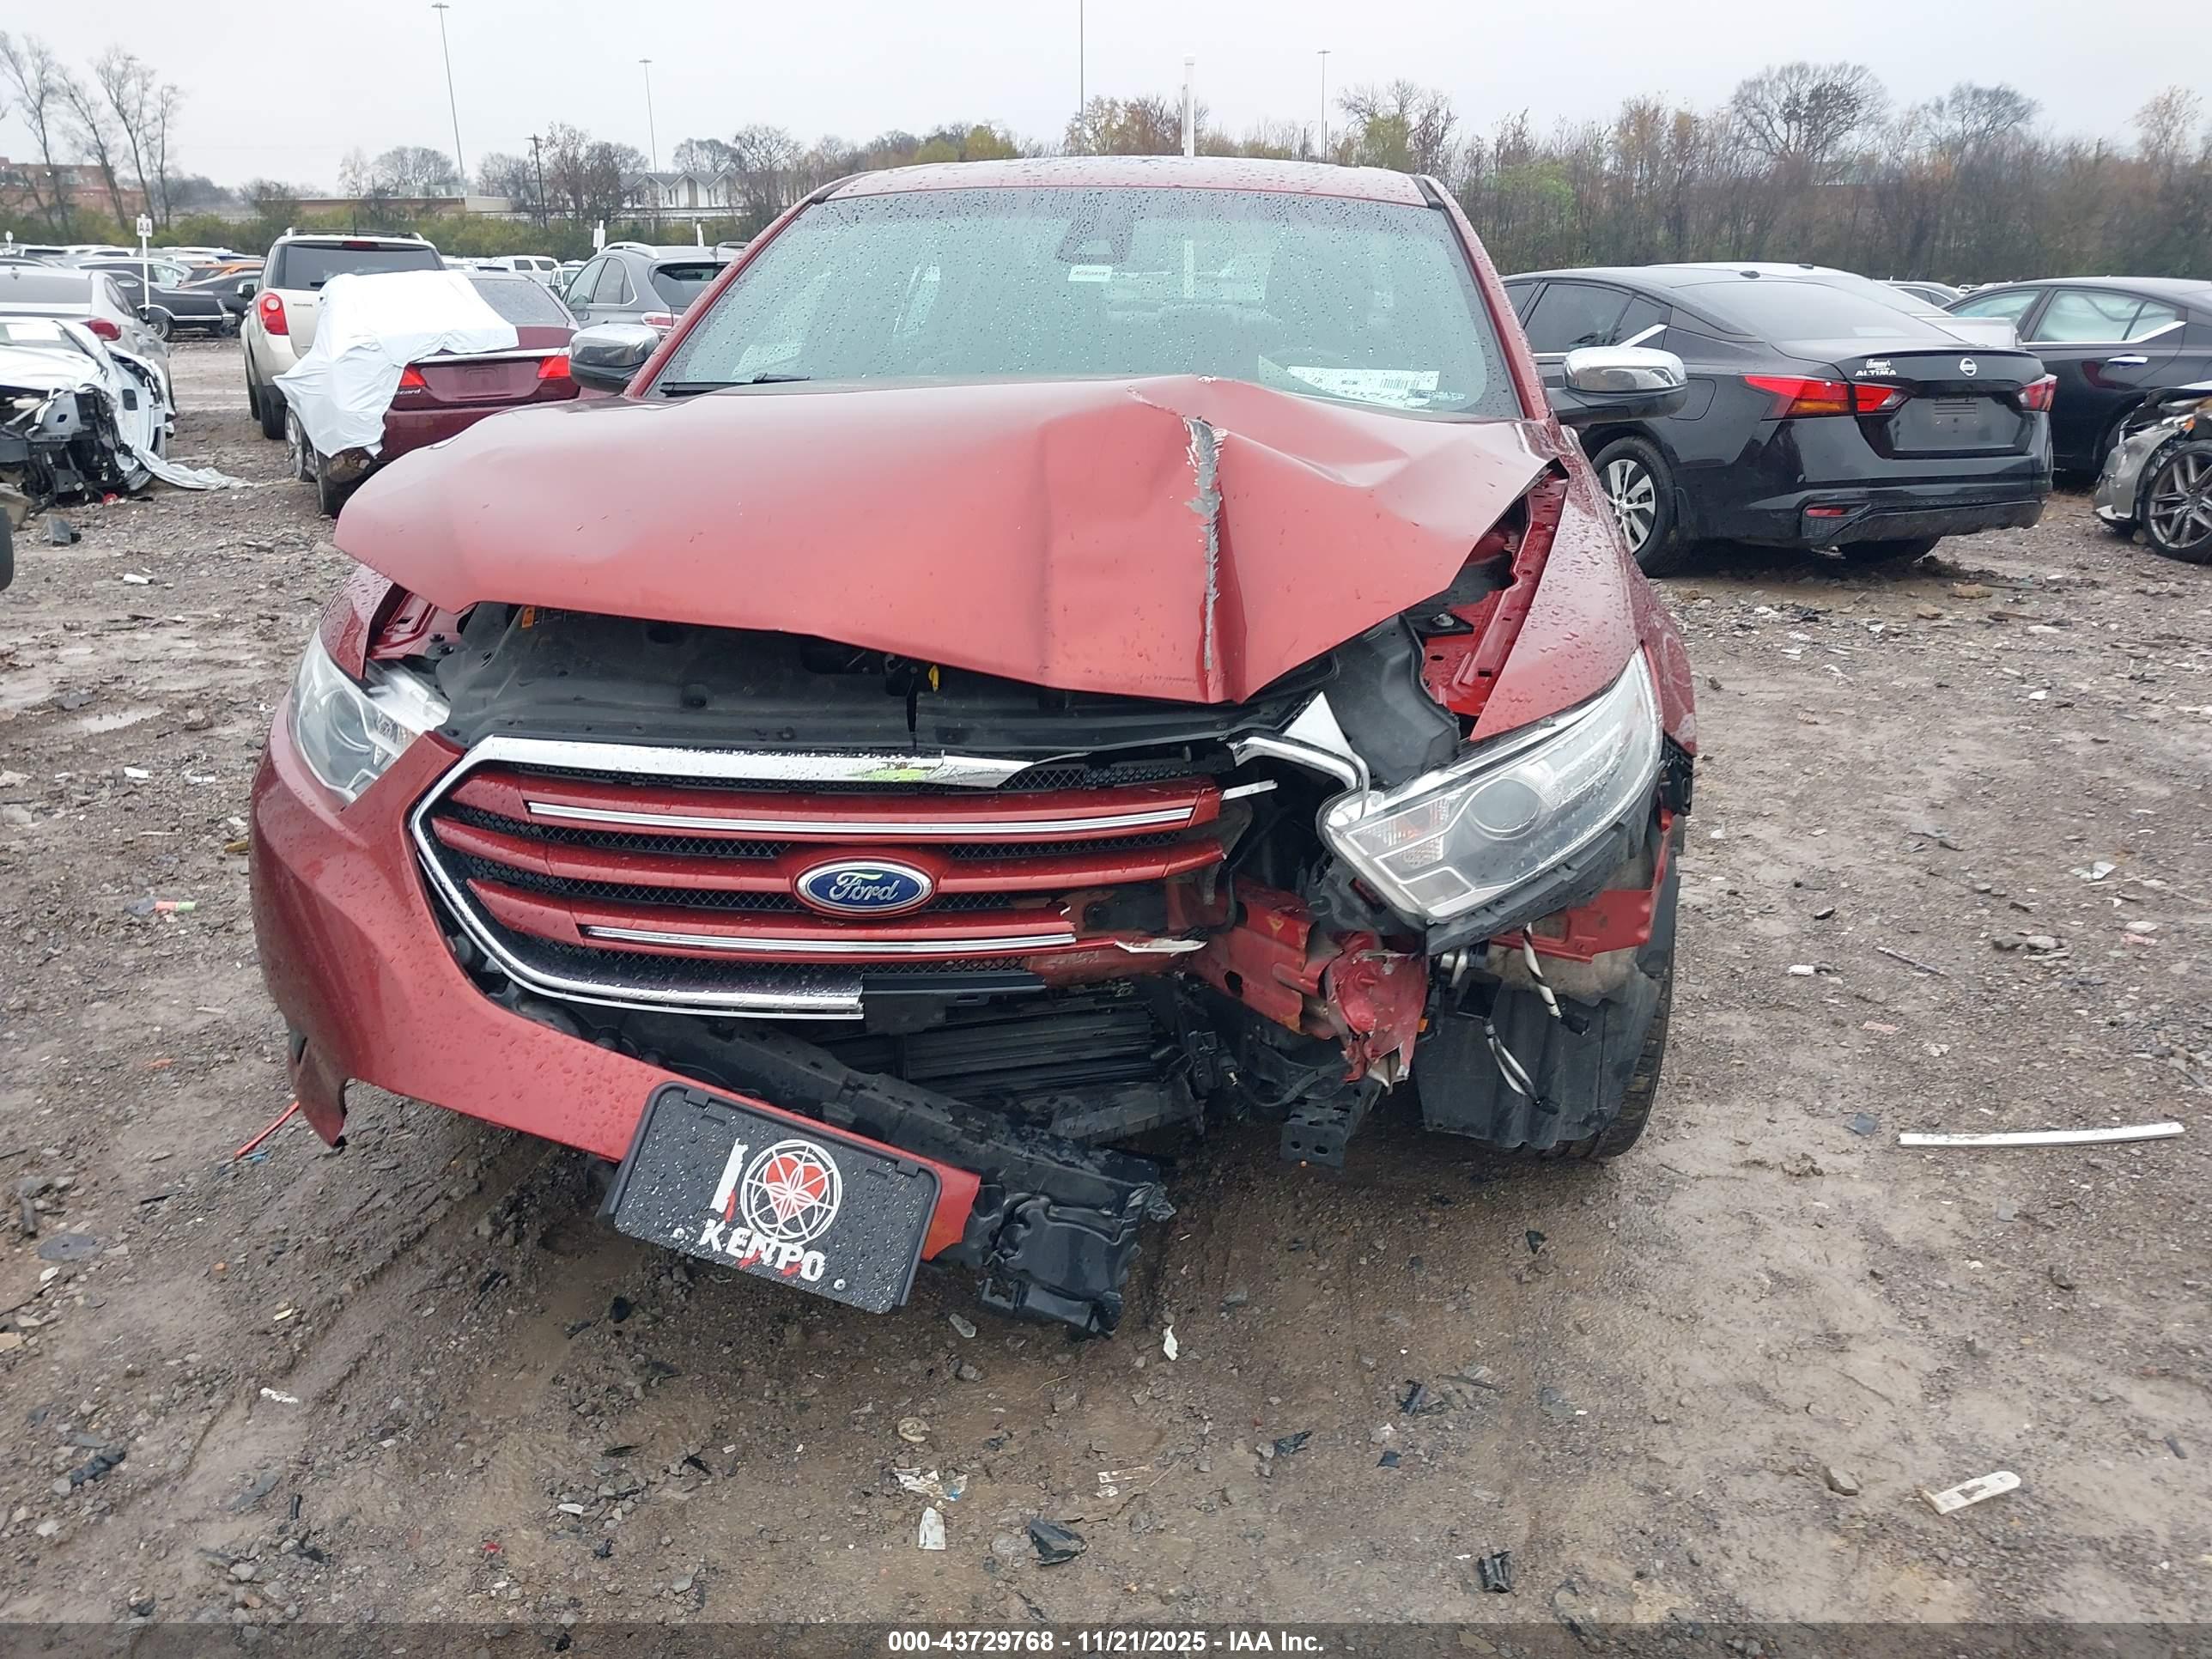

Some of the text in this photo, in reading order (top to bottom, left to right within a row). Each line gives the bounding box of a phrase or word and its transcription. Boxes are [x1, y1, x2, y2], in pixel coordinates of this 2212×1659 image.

[138, 222, 151, 234] AA
[395, 387, 422, 396] ccord
[829, 871, 901, 901] Ford
[699, 1218, 826, 1282] KENPO
